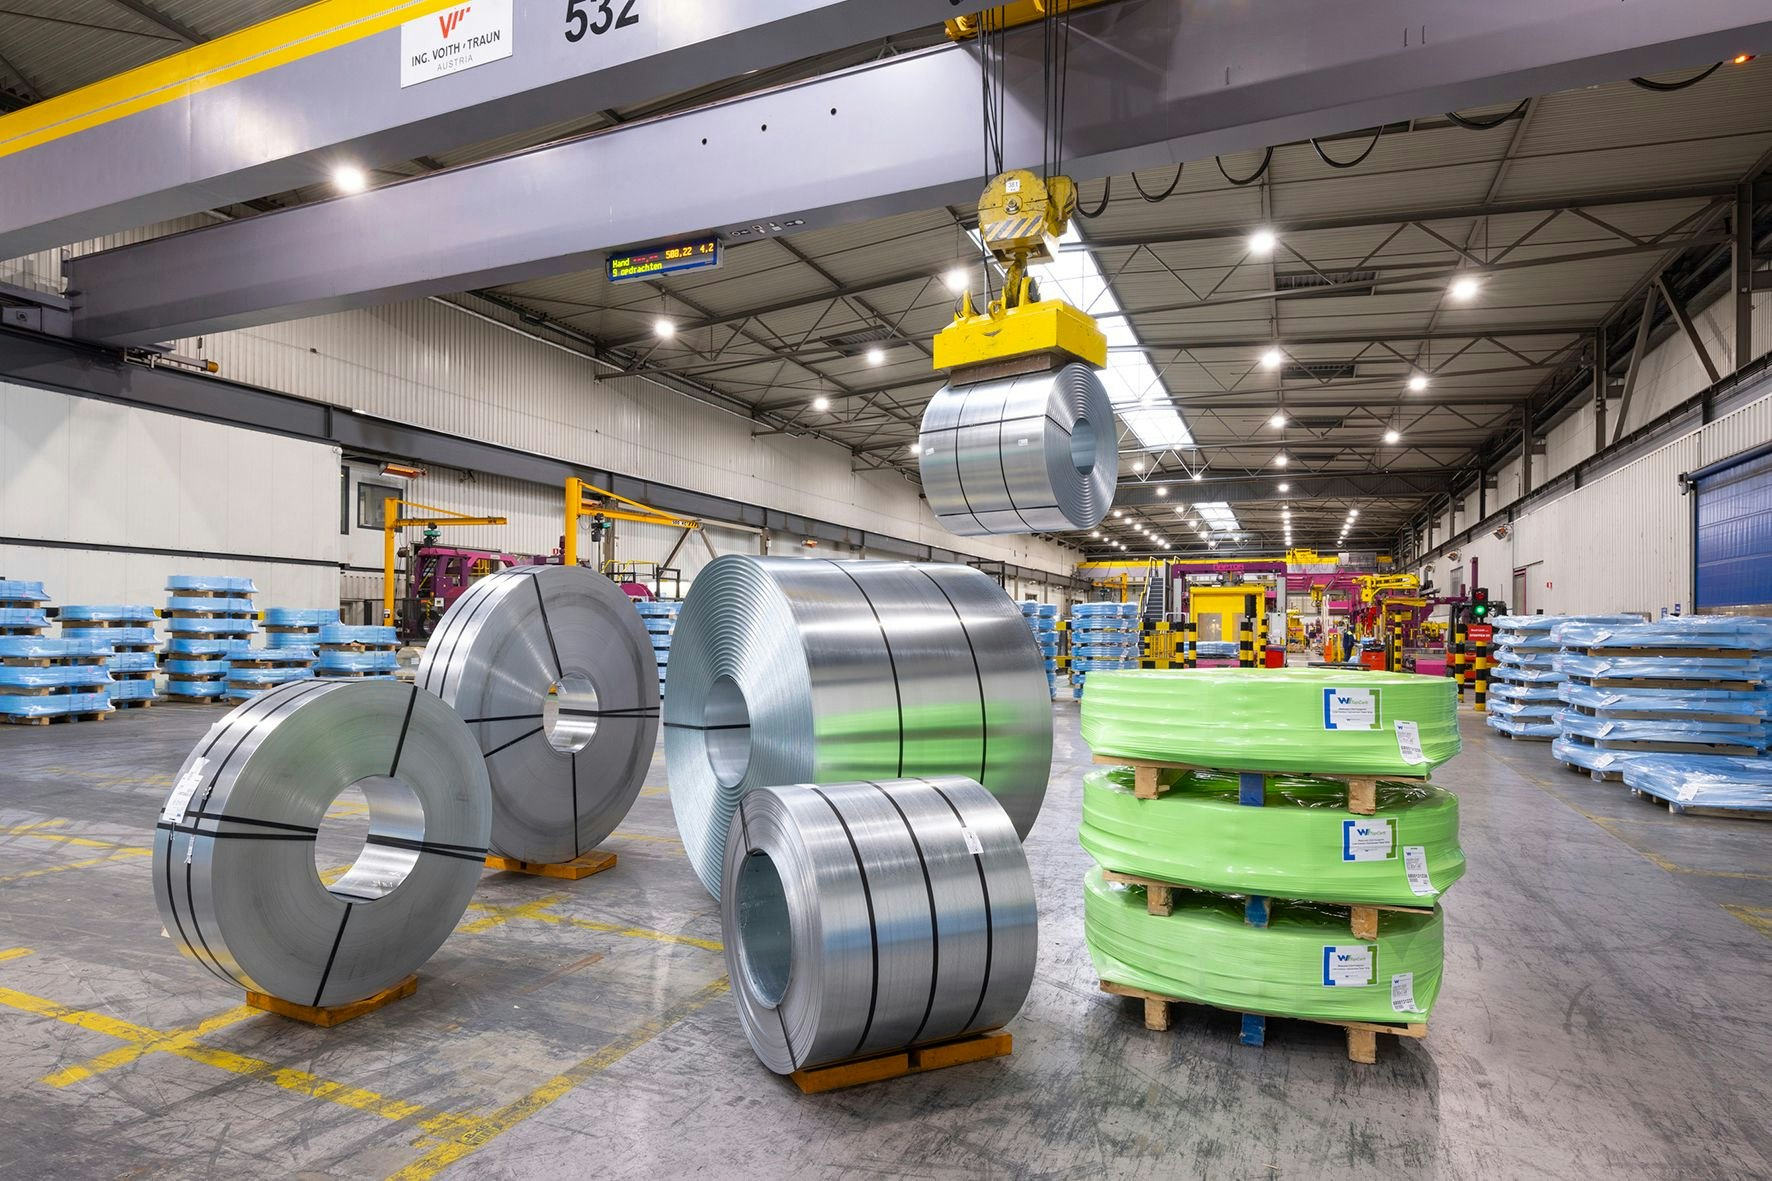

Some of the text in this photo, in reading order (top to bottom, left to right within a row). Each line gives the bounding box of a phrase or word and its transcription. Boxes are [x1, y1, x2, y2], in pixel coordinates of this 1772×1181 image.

[564, 0, 639, 43] 532
[411, 29, 500, 67] ING. VOITH TRAUN
[437, 54, 473, 71] AUSTRIA
